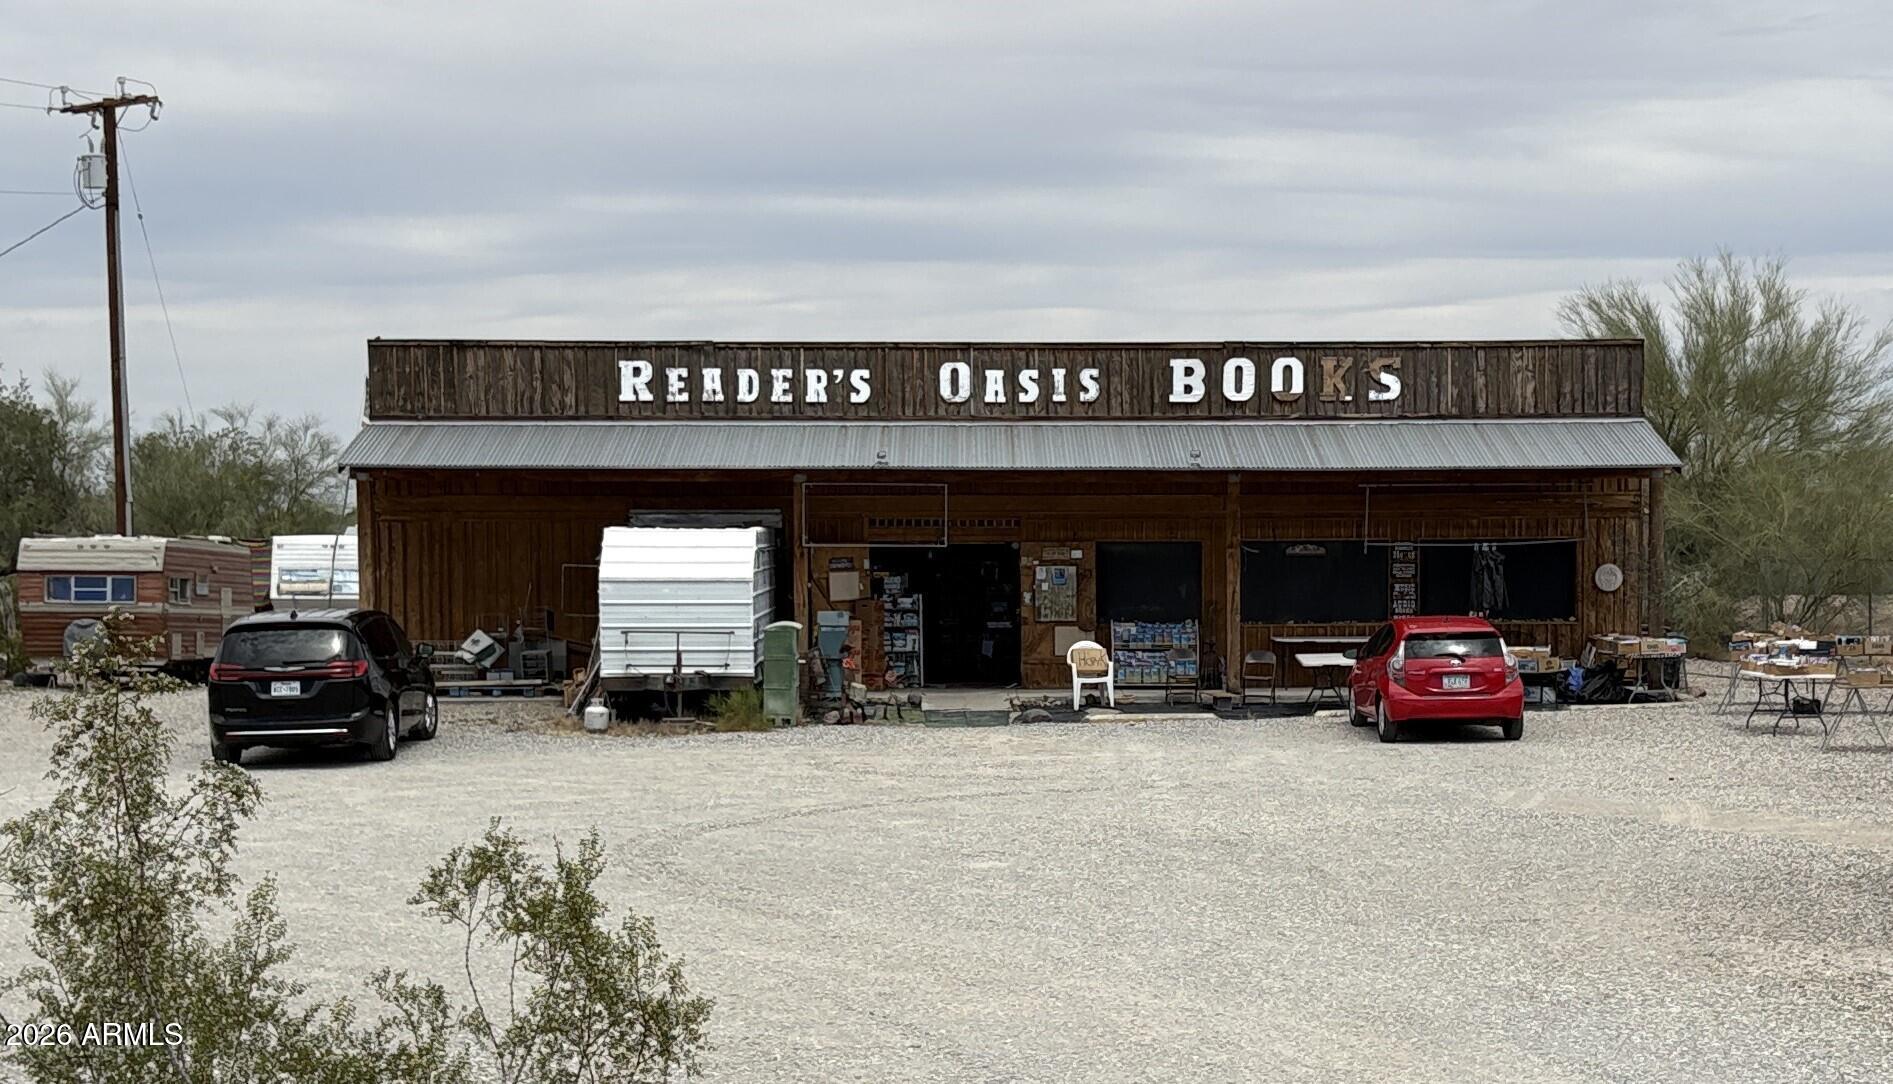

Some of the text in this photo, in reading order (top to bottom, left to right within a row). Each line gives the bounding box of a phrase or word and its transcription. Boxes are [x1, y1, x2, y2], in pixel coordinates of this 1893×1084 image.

[618, 357, 1403, 404] READER'S OASIS BOOKS
